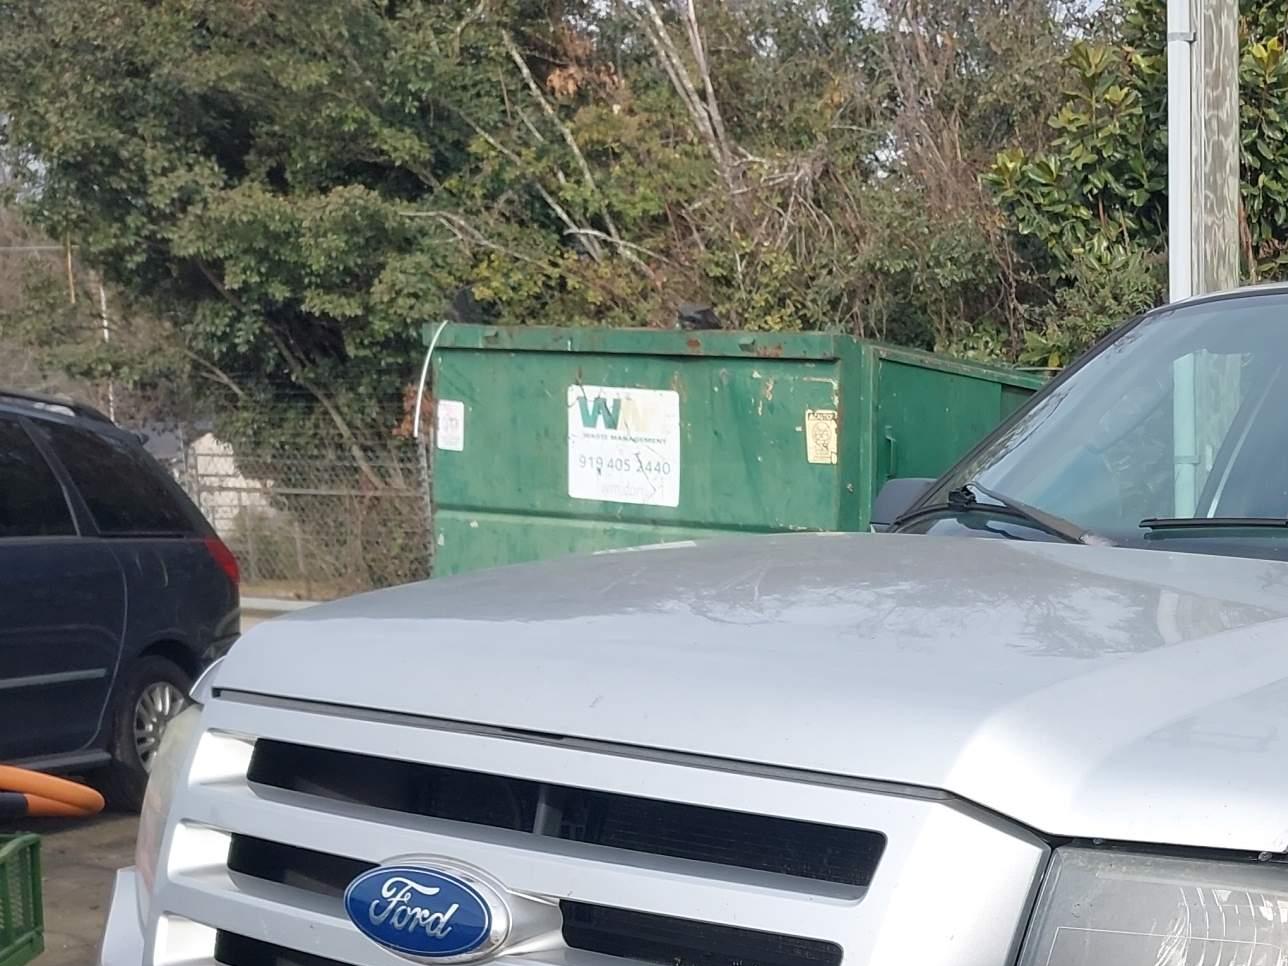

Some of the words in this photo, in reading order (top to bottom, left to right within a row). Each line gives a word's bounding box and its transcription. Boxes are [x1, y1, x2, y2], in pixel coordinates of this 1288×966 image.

[582, 432, 608, 441] WASTE
[578, 454, 603, 469] 919
[607, 457, 631, 472] 405
[369, 876, 460, 939] Ford
